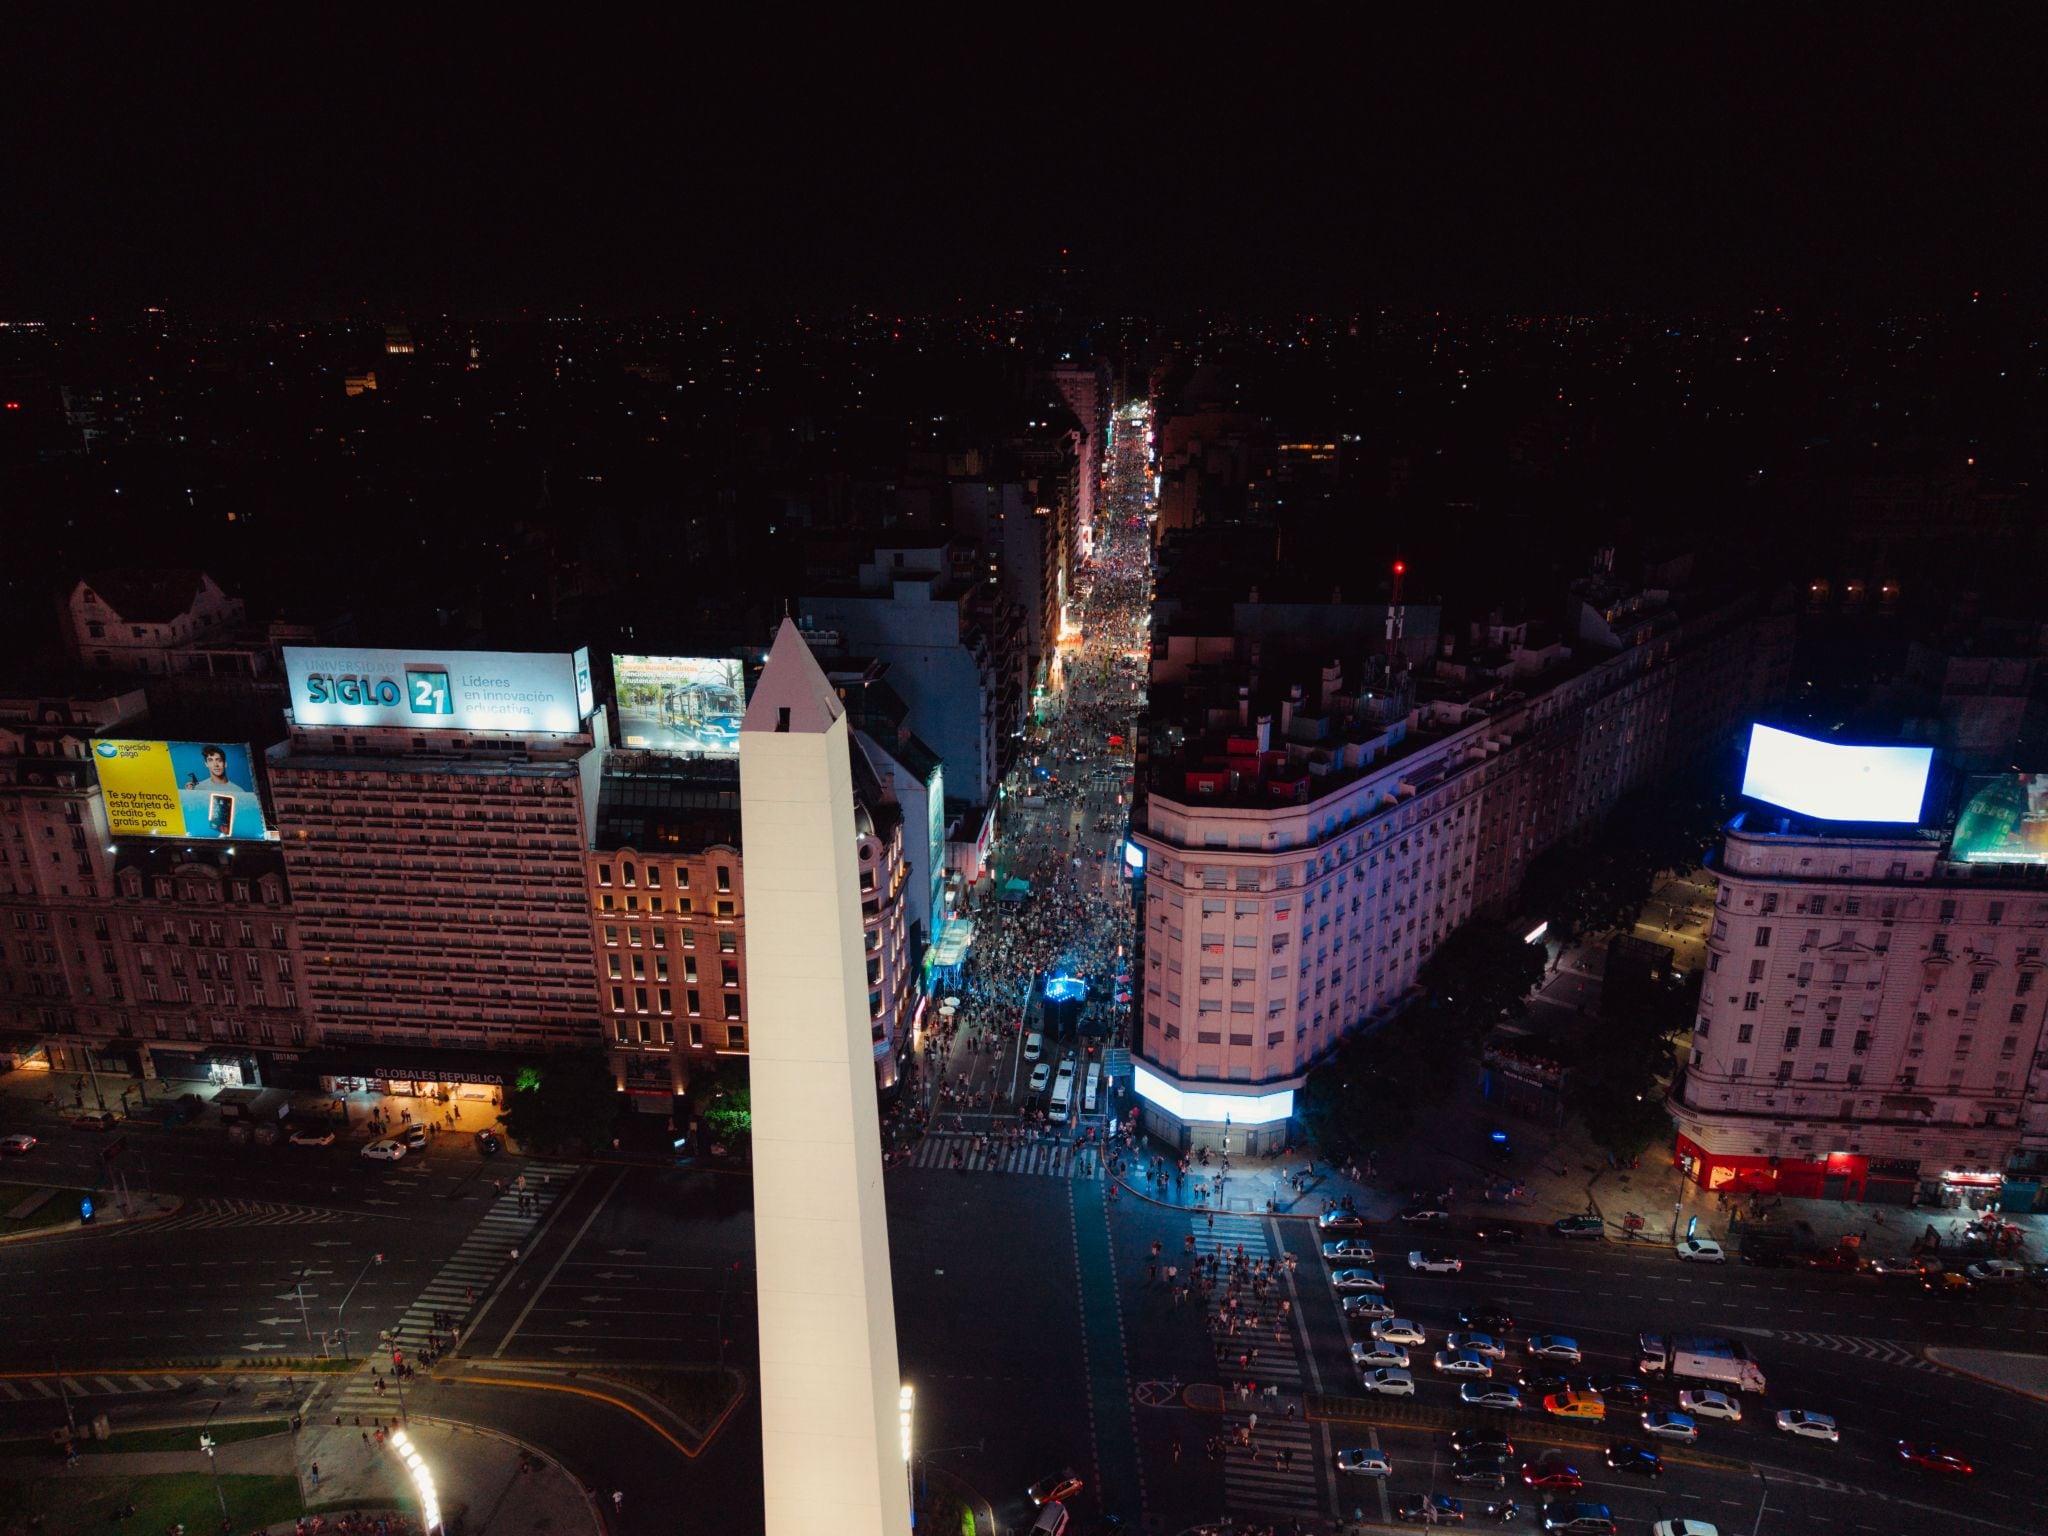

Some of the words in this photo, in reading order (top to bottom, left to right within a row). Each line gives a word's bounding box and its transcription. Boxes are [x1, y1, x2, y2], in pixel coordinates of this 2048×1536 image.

[304, 659, 396, 673] UNIVERSIDAD
[306, 674, 401, 706] SIGLO
[415, 680, 445, 714] 21
[464, 691, 480, 700] en
[483, 689, 554, 702] innovación
[118, 743, 151, 752] mercado
[107, 790, 119, 799] Te
[121, 793, 137, 801] soy
[131, 801, 162, 810] tarjeta
[163, 802, 176, 810] de
[111, 808, 144, 817] crédito
[113, 817, 140, 827] gratis
[141, 819, 168, 828] posta
[375, 1068, 437, 1081] GLOBALES
[439, 1071, 504, 1085] REPUBLICA
